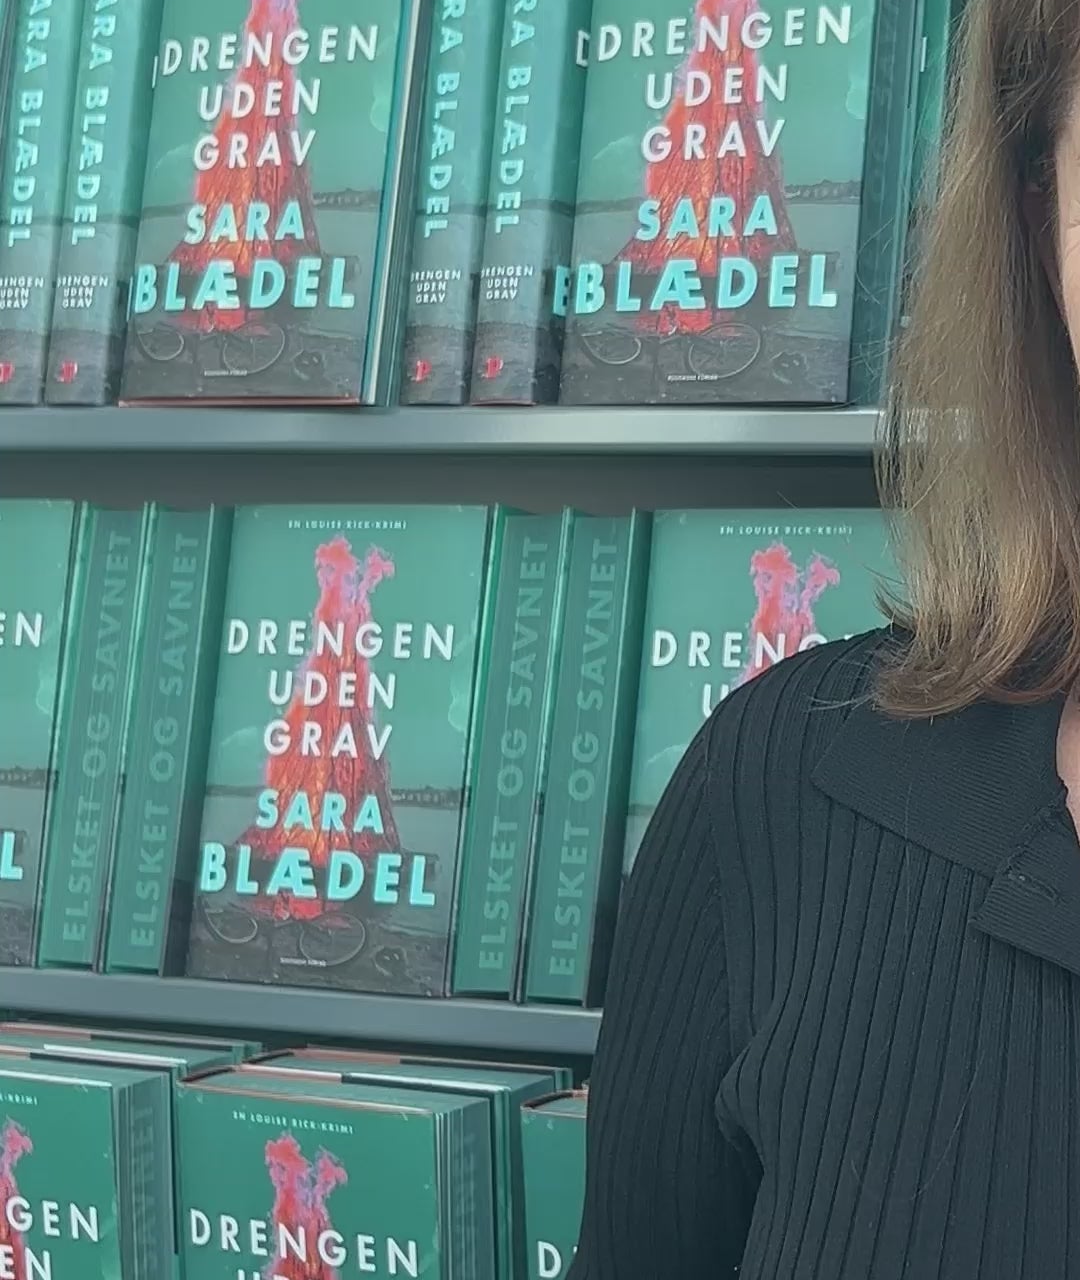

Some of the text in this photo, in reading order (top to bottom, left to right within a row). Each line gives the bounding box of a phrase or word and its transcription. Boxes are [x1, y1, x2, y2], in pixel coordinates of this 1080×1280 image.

[162, 26, 378, 76] DRENGEN
[598, 5, 853, 62] DRENGEN
[199, 79, 322, 120] UDEN
[646, 64, 788, 111] UDEN
[194, 131, 316, 170] GRAV
[423, 71, 460, 238] BLÆDEL
[494, 65, 531, 234] BLÆDEL
[641, 120, 786, 163] GRAV
[8, 89, 44, 247] BLÆDEL
[71, 87, 108, 245] BLÆDEL
[184, 202, 305, 244] SARA
[636, 195, 778, 242] SARA
[135, 258, 355, 313] BLÆDEL
[574, 254, 839, 315] BLÆDEL
[227, 618, 455, 660] DRENGEN
[268, 670, 396, 709] UDEN
[262, 720, 393, 761] GRAV
[256, 788, 384, 834] SARA
[200, 842, 435, 906] BLÆDEL
[190, 1209, 418, 1278] DRENGEN
